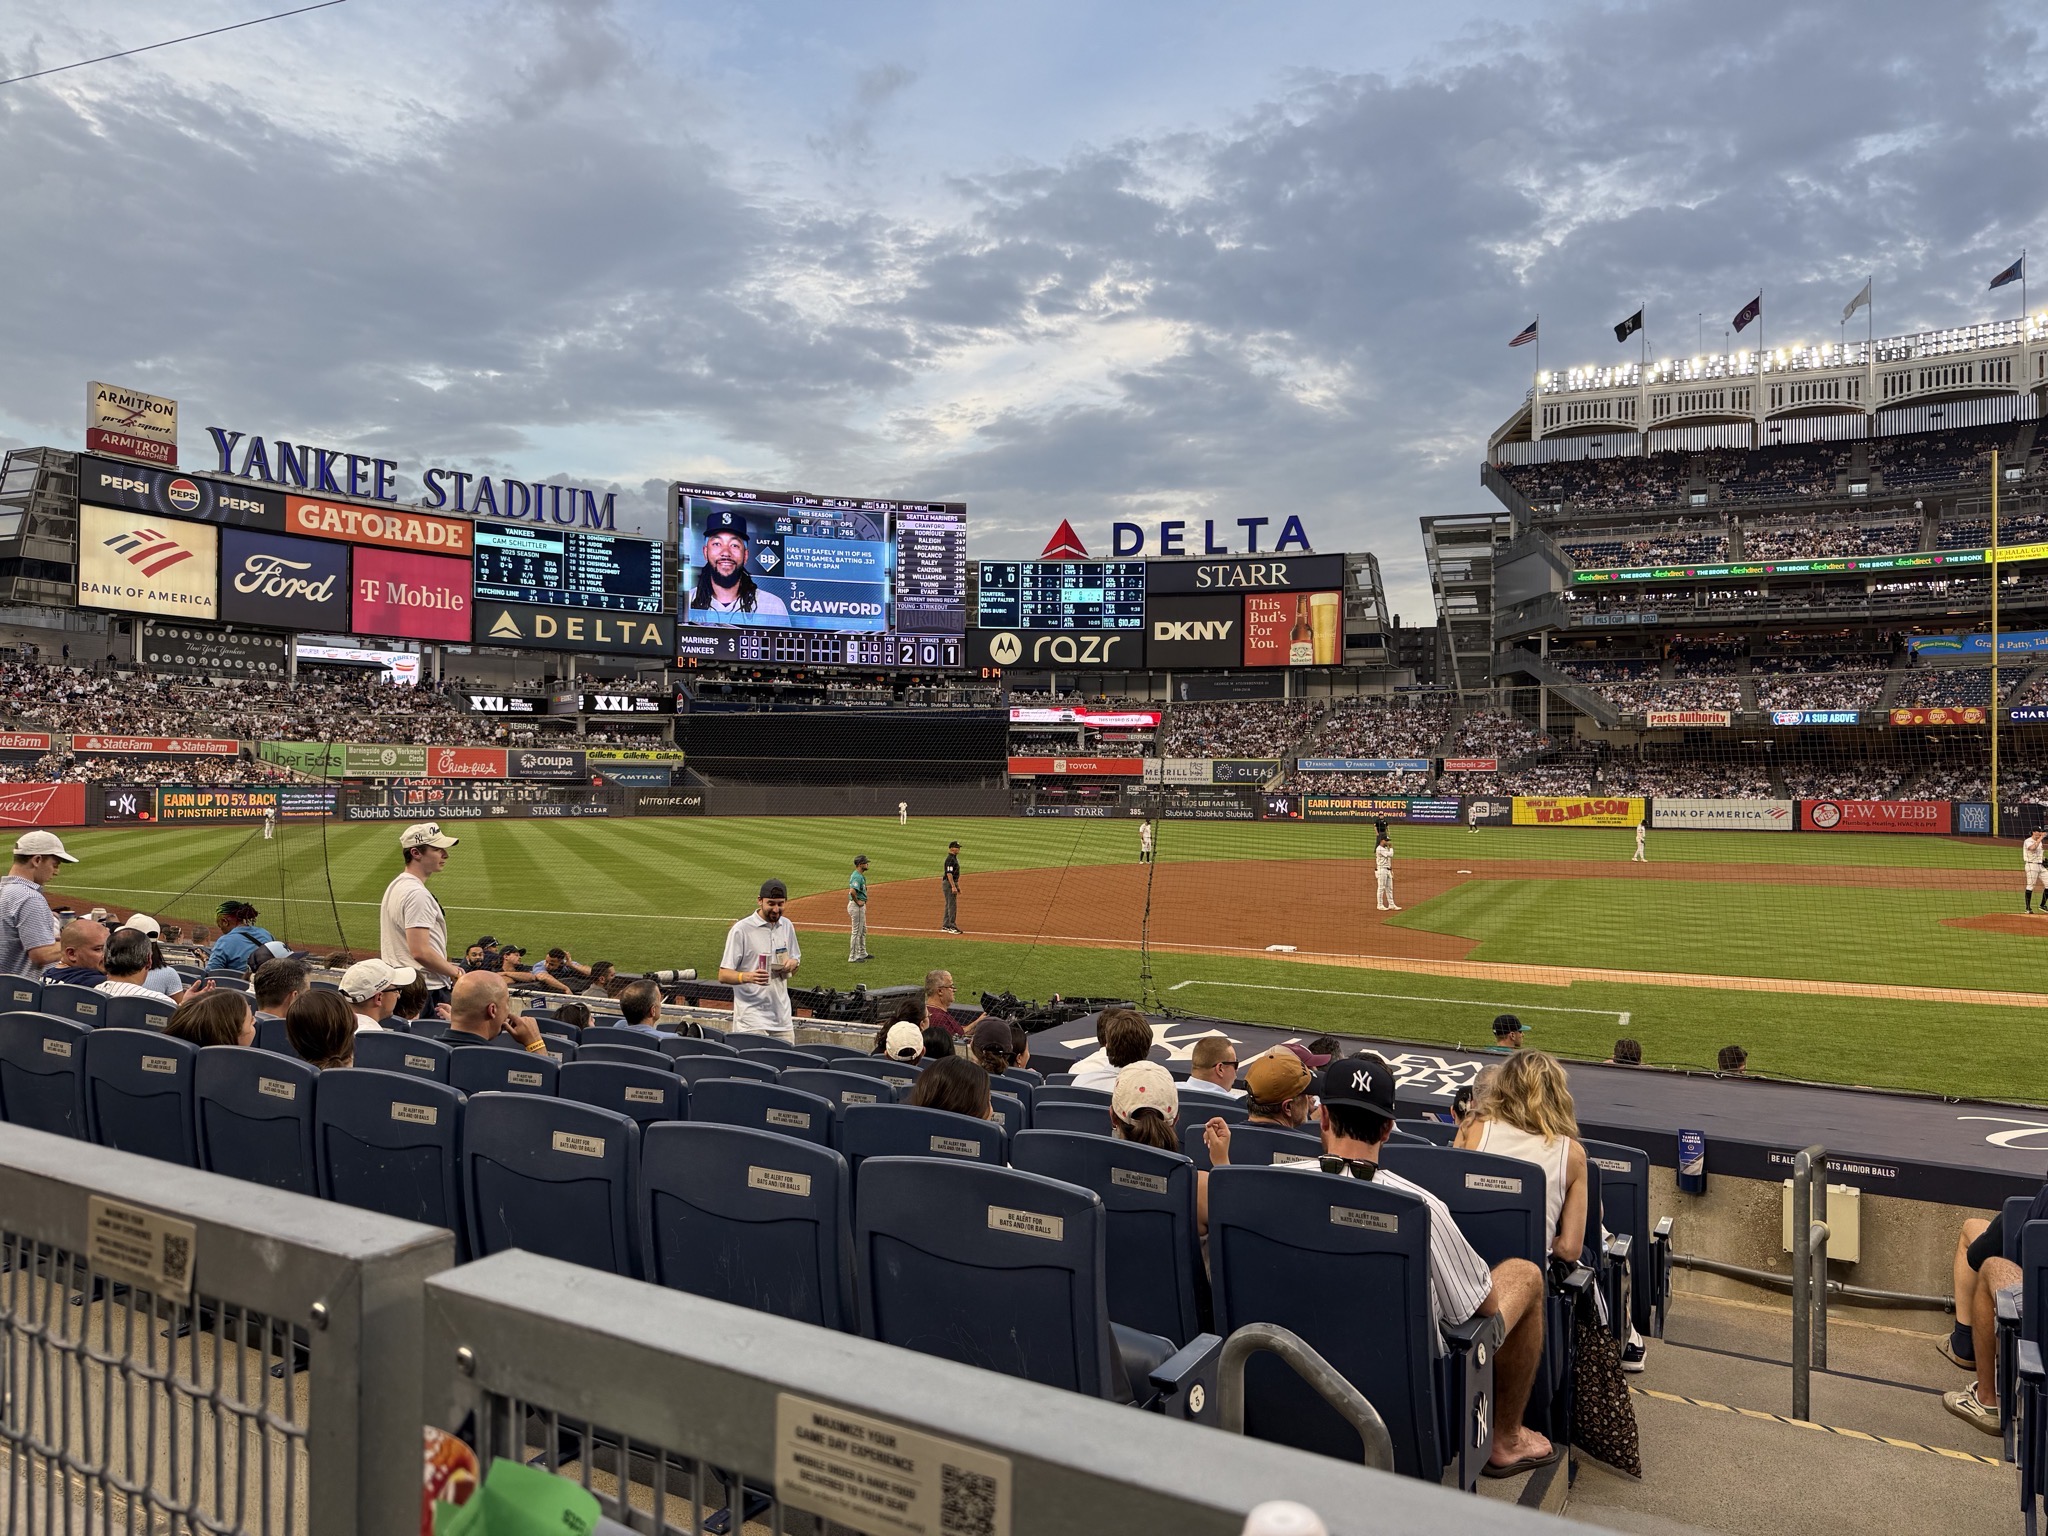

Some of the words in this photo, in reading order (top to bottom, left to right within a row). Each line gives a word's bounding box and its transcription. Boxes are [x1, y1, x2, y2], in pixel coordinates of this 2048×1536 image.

[97, 390, 174, 417] ARMITRON
[101, 434, 170, 456] ARMITRON
[135, 449, 168, 462] WATCHES
[101, 474, 150, 494] PEPSI
[206, 426, 398, 503] YANKEE
[422, 468, 618, 531] STADIUM
[171, 490, 199, 501] PEPSI
[220, 496, 265, 514] PEPSI
[298, 504, 464, 548] GATORADE
[505, 528, 535, 538] YANKEES
[1113, 515, 1311, 557] DELTA
[492, 537, 507, 546] CAM
[508, 539, 548, 550] SCHLITTLER
[516, 550, 540, 558] SEASON
[760, 553, 777, 565] BB
[811, 555, 835, 563] GAMES,
[812, 549, 836, 557] SAFELY
[1896, 558, 1931, 568] freshdirect
[234, 554, 336, 602] Ford
[1196, 563, 1290, 589] STARR
[82, 582, 121, 596] BANK
[126, 587, 144, 599] OF
[148, 590, 212, 606] AMERICA
[360, 579, 380, 602] T
[386, 582, 464, 610] Mobile
[477, 587, 506, 596] PITCHING
[506, 589, 520, 597] LINE
[791, 591, 807, 601] J.P.
[638, 601, 659, 612] 7:47
[790, 600, 882, 616] CRAWFORD
[1249, 598, 1281, 610] This
[1249, 610, 1286, 623] Bud's
[1611, 615, 1622, 624] CUP
[1642, 614, 1657, 623] 2021
[536, 615, 662, 646] DELTA
[1154, 621, 1233, 641] DKNY
[1249, 624, 1272, 636] For
[681, 635, 719, 646] MARINERS
[1249, 637, 1279, 649] You.
[185, 643, 201, 653] New
[201, 644, 218, 656] York
[219, 644, 246, 656] Yankees
[681, 646, 715, 655] YANKEES
[902, 645, 914, 662] 2
[924, 645, 935, 663] 0
[947, 646, 956, 664] 1
[1033, 636, 1121, 663] razr
[677, 656, 698, 668] 0:14
[470, 696, 509, 711] XXL
[594, 695, 634, 711] XXL
[1651, 713, 1678, 723] Parts
[1678, 712, 1727, 724] Authority
[1804, 714, 1810, 722] A
[1812, 713, 1827, 722] SUB
[1829, 713, 1857, 723] ABOVE
[510, 722, 539, 731] TERRACE
[264, 748, 301, 766] Uber
[304, 749, 343, 768] Eats
[536, 755, 573, 768] coupa
[588, 751, 616, 760] Gillette
[623, 752, 650, 761] Gillette
[655, 752, 682, 761] Gillette
[438, 753, 497, 775] Chick-fil-A
[1446, 761, 1477, 769] Reebok
[619, 773, 662, 781] AMTRAK
[164, 794, 193, 806] EARN
[194, 794, 210, 806] UP
[212, 794, 229, 806] TO
[231, 793, 247, 806] 5%
[249, 793, 277, 806] BACK
[639, 796, 701, 808] NITTOTIRE.COM
[1308, 799, 1329, 808] EARN
[1330, 799, 1352, 808] FOUR
[1353, 800, 1373, 808] FREE
[164, 808, 173, 818] IN
[174, 808, 229, 818] PINSTRIPE
[231, 808, 264, 817] REWAR
[350, 807, 391, 819] StubHub
[393, 806, 435, 818] StubHub
[439, 806, 482, 817] StubHub
[532, 806, 562, 816] STARR
[1075, 806, 1104, 817] STARR
[1165, 810, 1194, 819] StubHub
[1196, 810, 1224, 819] StubHub
[1225, 810, 1254, 819] StubHub
[1654, 809, 1684, 818] BANK
[1687, 809, 1704, 818] OF
[1706, 810, 1760, 819] AMERICA
[1842, 804, 1876, 819] F.W.
[1879, 804, 1938, 819] WEBB
[1963, 807, 1984, 815] NEW
[2002, 805, 2018, 814] 314
[1961, 813, 1986, 822] YORK
[1963, 821, 1984, 829] LIFE
[572, 1137, 583, 1145] ALERT
[569, 1142, 584, 1151] AND/OR
[584, 1145, 596, 1153] BALLS
[1771, 1154, 1780, 1162] BE
[1781, 1155, 1795, 1165] ALE
[1826, 1162, 1841, 1171] ATS
[1842, 1164, 1871, 1174] AND/OR
[1872, 1167, 1896, 1177] BALLS
[764, 1172, 771, 1180] BE
[772, 1173, 785, 1182] ALERT
[785, 1174, 793, 1183] FOR
[757, 1178, 768, 1186] BATS
[768, 1179, 786, 1189] AND/OR
[787, 1182, 801, 1191] BALLS
[1016, 1215, 1032, 1223] ALERT
[1033, 1217, 1043, 1225] FOR
[1000, 1219, 1013, 1227] BATS
[1013, 1221, 1035, 1231] AND/OR
[1035, 1224, 1052, 1234] BALLS
